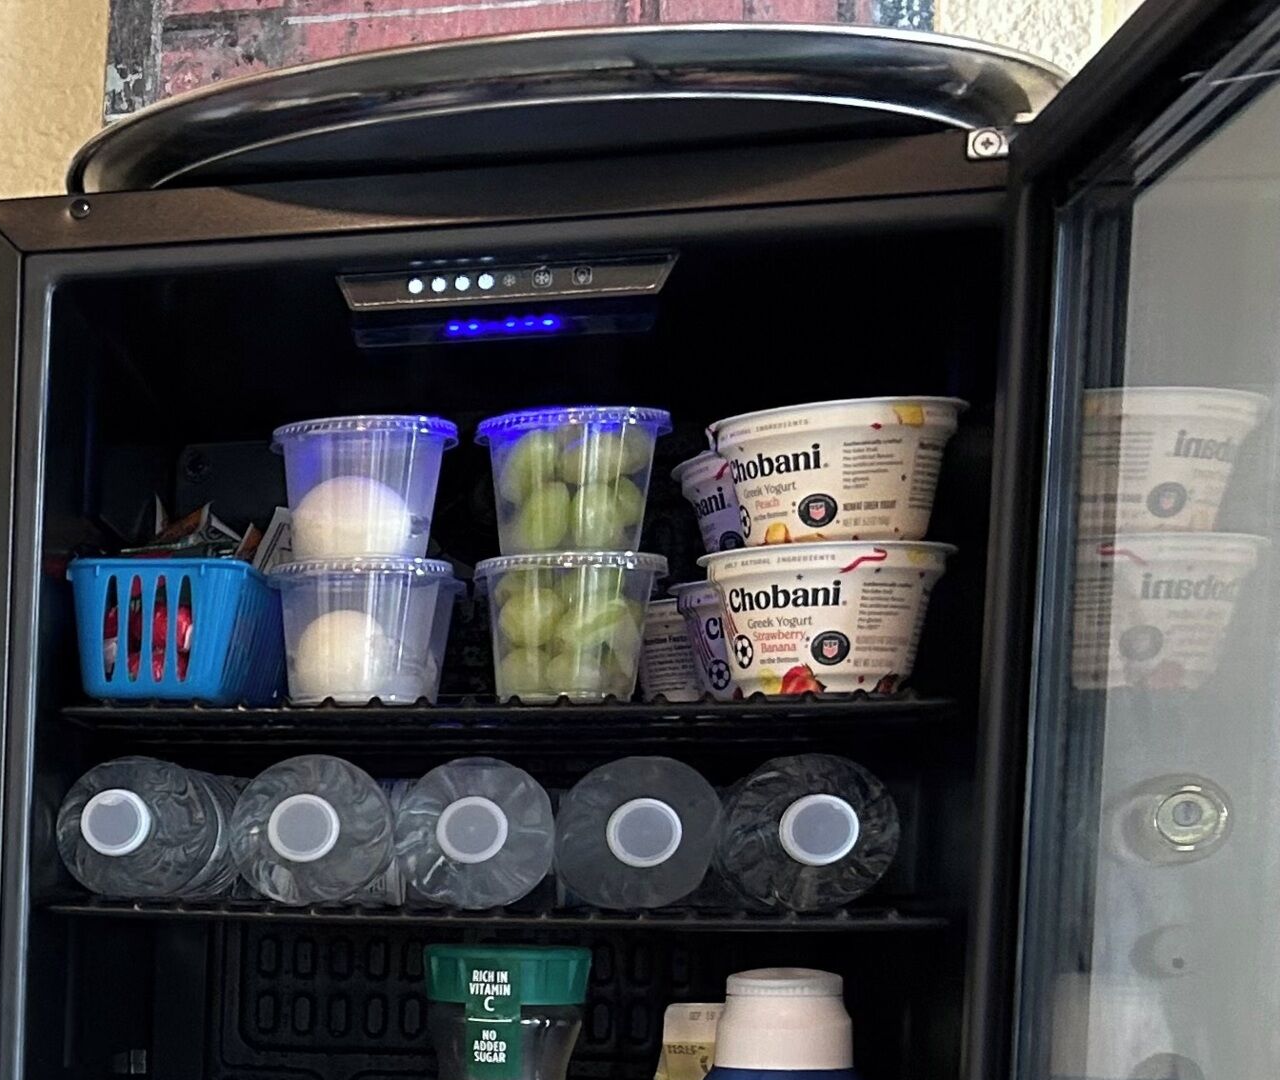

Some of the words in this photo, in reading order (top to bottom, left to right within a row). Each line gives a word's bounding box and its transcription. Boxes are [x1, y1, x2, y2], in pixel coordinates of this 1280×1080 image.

[731, 443, 822, 485] Chobani
[764, 481, 797, 496] Yogurt
[755, 498, 781, 511] Peach
[729, 580, 842, 613] Chobani
[747, 616, 774, 629] Greek
[776, 616, 813, 628] Yogurt
[753, 630, 806, 641] Strawberry
[761, 643, 797, 653] Banana
[473, 970, 494, 983] RICH
[497, 971, 508, 983] IN
[469, 983, 511, 996] VITAMIN
[484, 996, 495, 1011] C
[482, 1030, 497, 1040] NO
[473, 1040, 507, 1052] ADDED
[474, 1052, 506, 1063] SUGAR
